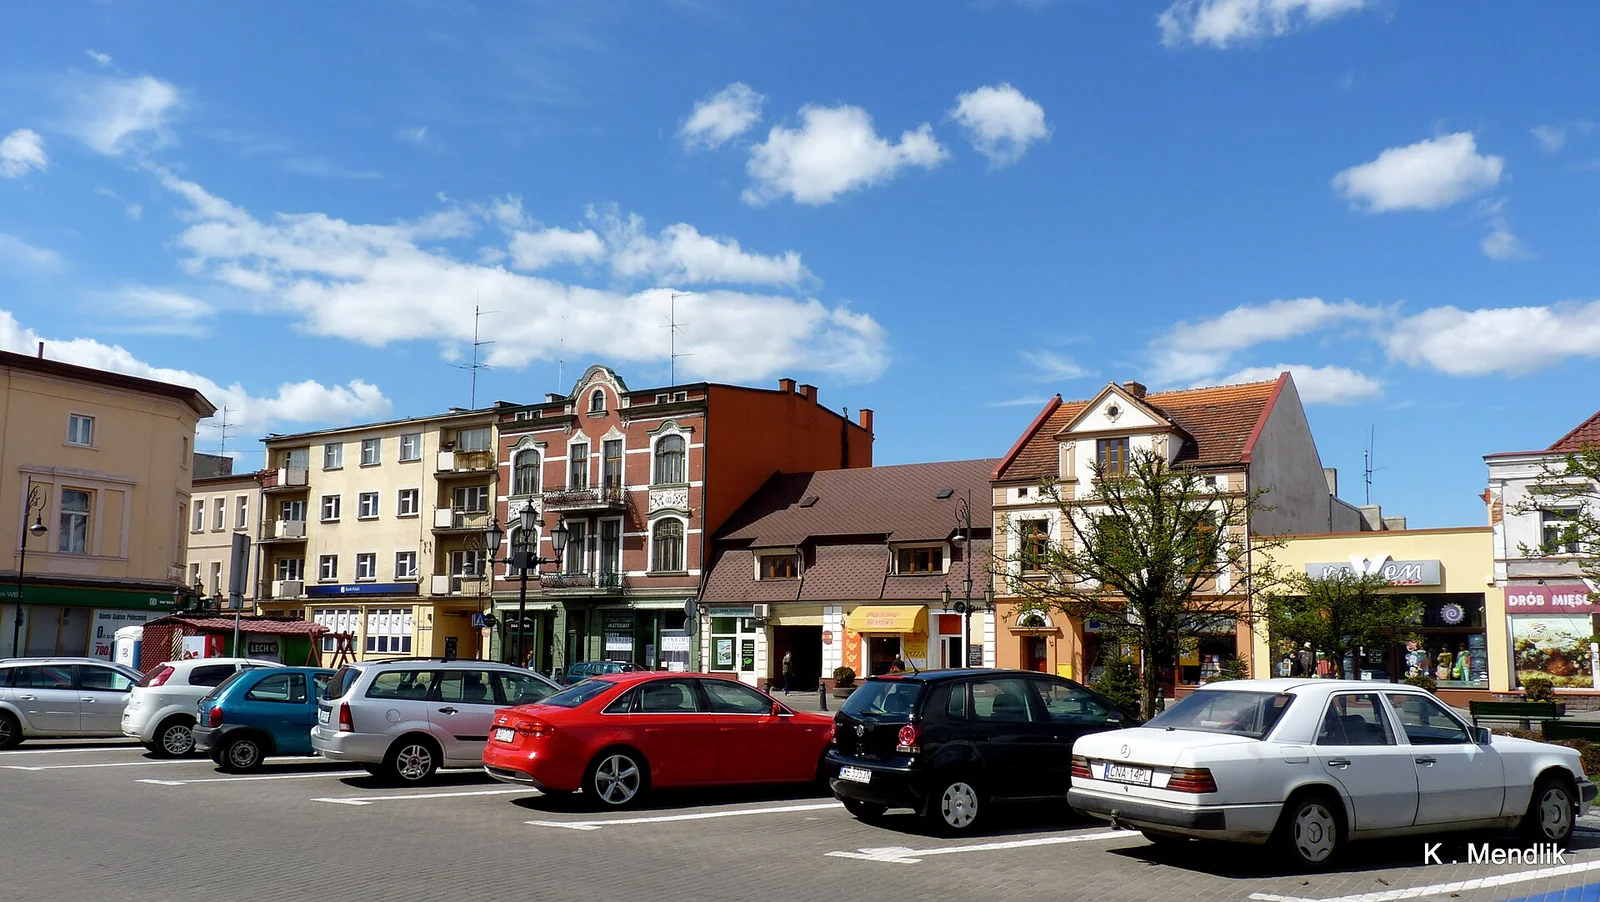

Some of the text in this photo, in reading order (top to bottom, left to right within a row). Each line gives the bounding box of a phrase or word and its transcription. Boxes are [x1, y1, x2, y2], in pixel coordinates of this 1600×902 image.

[1508, 590, 1545, 604] DRÓB
[95, 645, 109, 656] 700
[250, 644, 269, 652] LECH
[1110, 765, 1149, 781] CNA 14PL
